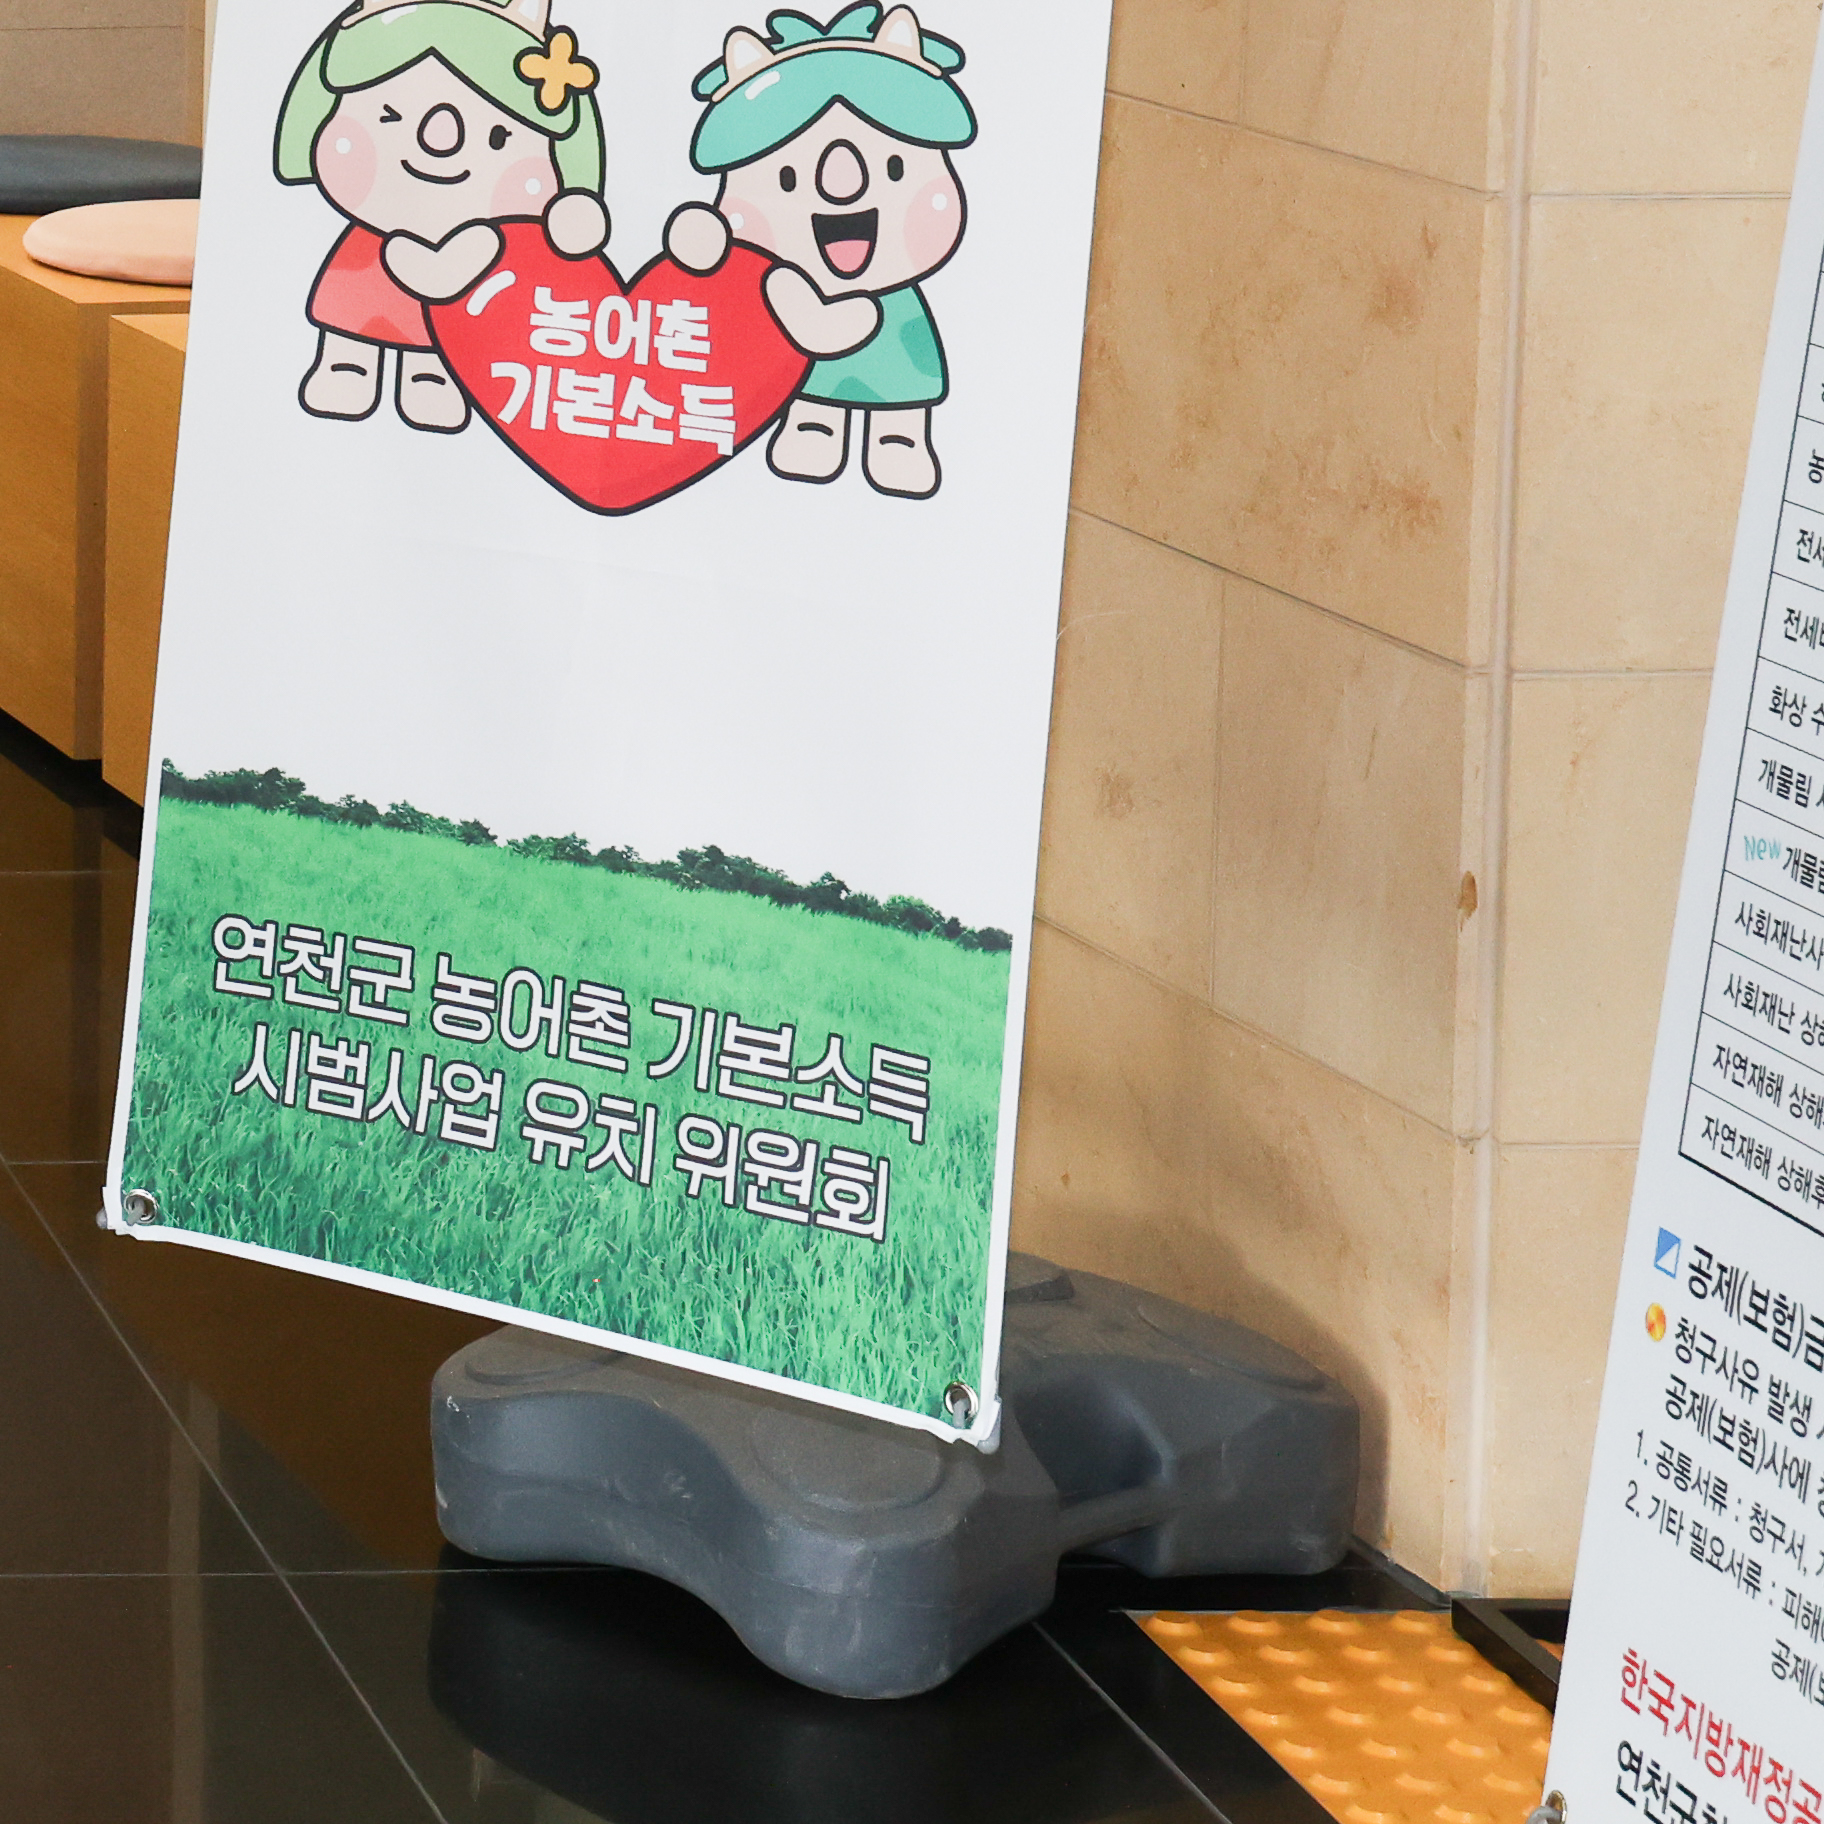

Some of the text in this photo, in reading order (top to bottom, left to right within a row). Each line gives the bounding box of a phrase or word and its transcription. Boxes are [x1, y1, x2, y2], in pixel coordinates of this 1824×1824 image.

[530, 286, 710, 373] 농어촌
[490, 362, 736, 455] 기본소득
[1769, 685, 1807, 727] 화상
[1758, 759, 1813, 808] 개물림
[1744, 835, 1781, 862] New
[211, 912, 932, 1143] 연천군 농어촌 기본소득
[1723, 973, 1795, 1035] 사회재난
[1712, 1044, 1824, 1130] 자연재해 상해
[232, 1021, 891, 1243] 시범사업 유치 위원회
[1702, 1115, 1773, 1180] 자연재해
[1675, 1316, 1813, 1438] 청구사유 발생
[1637, 1429, 1648, 1466] 1.
[1656, 1440, 1729, 1516] 공통서류
[1665, 1373, 1812, 1504] 공제(보험)사에
[1625, 1479, 1640, 1518] 2.
[1648, 1495, 1685, 1546] 기타
[1689, 1520, 1763, 1599] 필요서류
[1782, 1587, 1824, 1643] 피해
